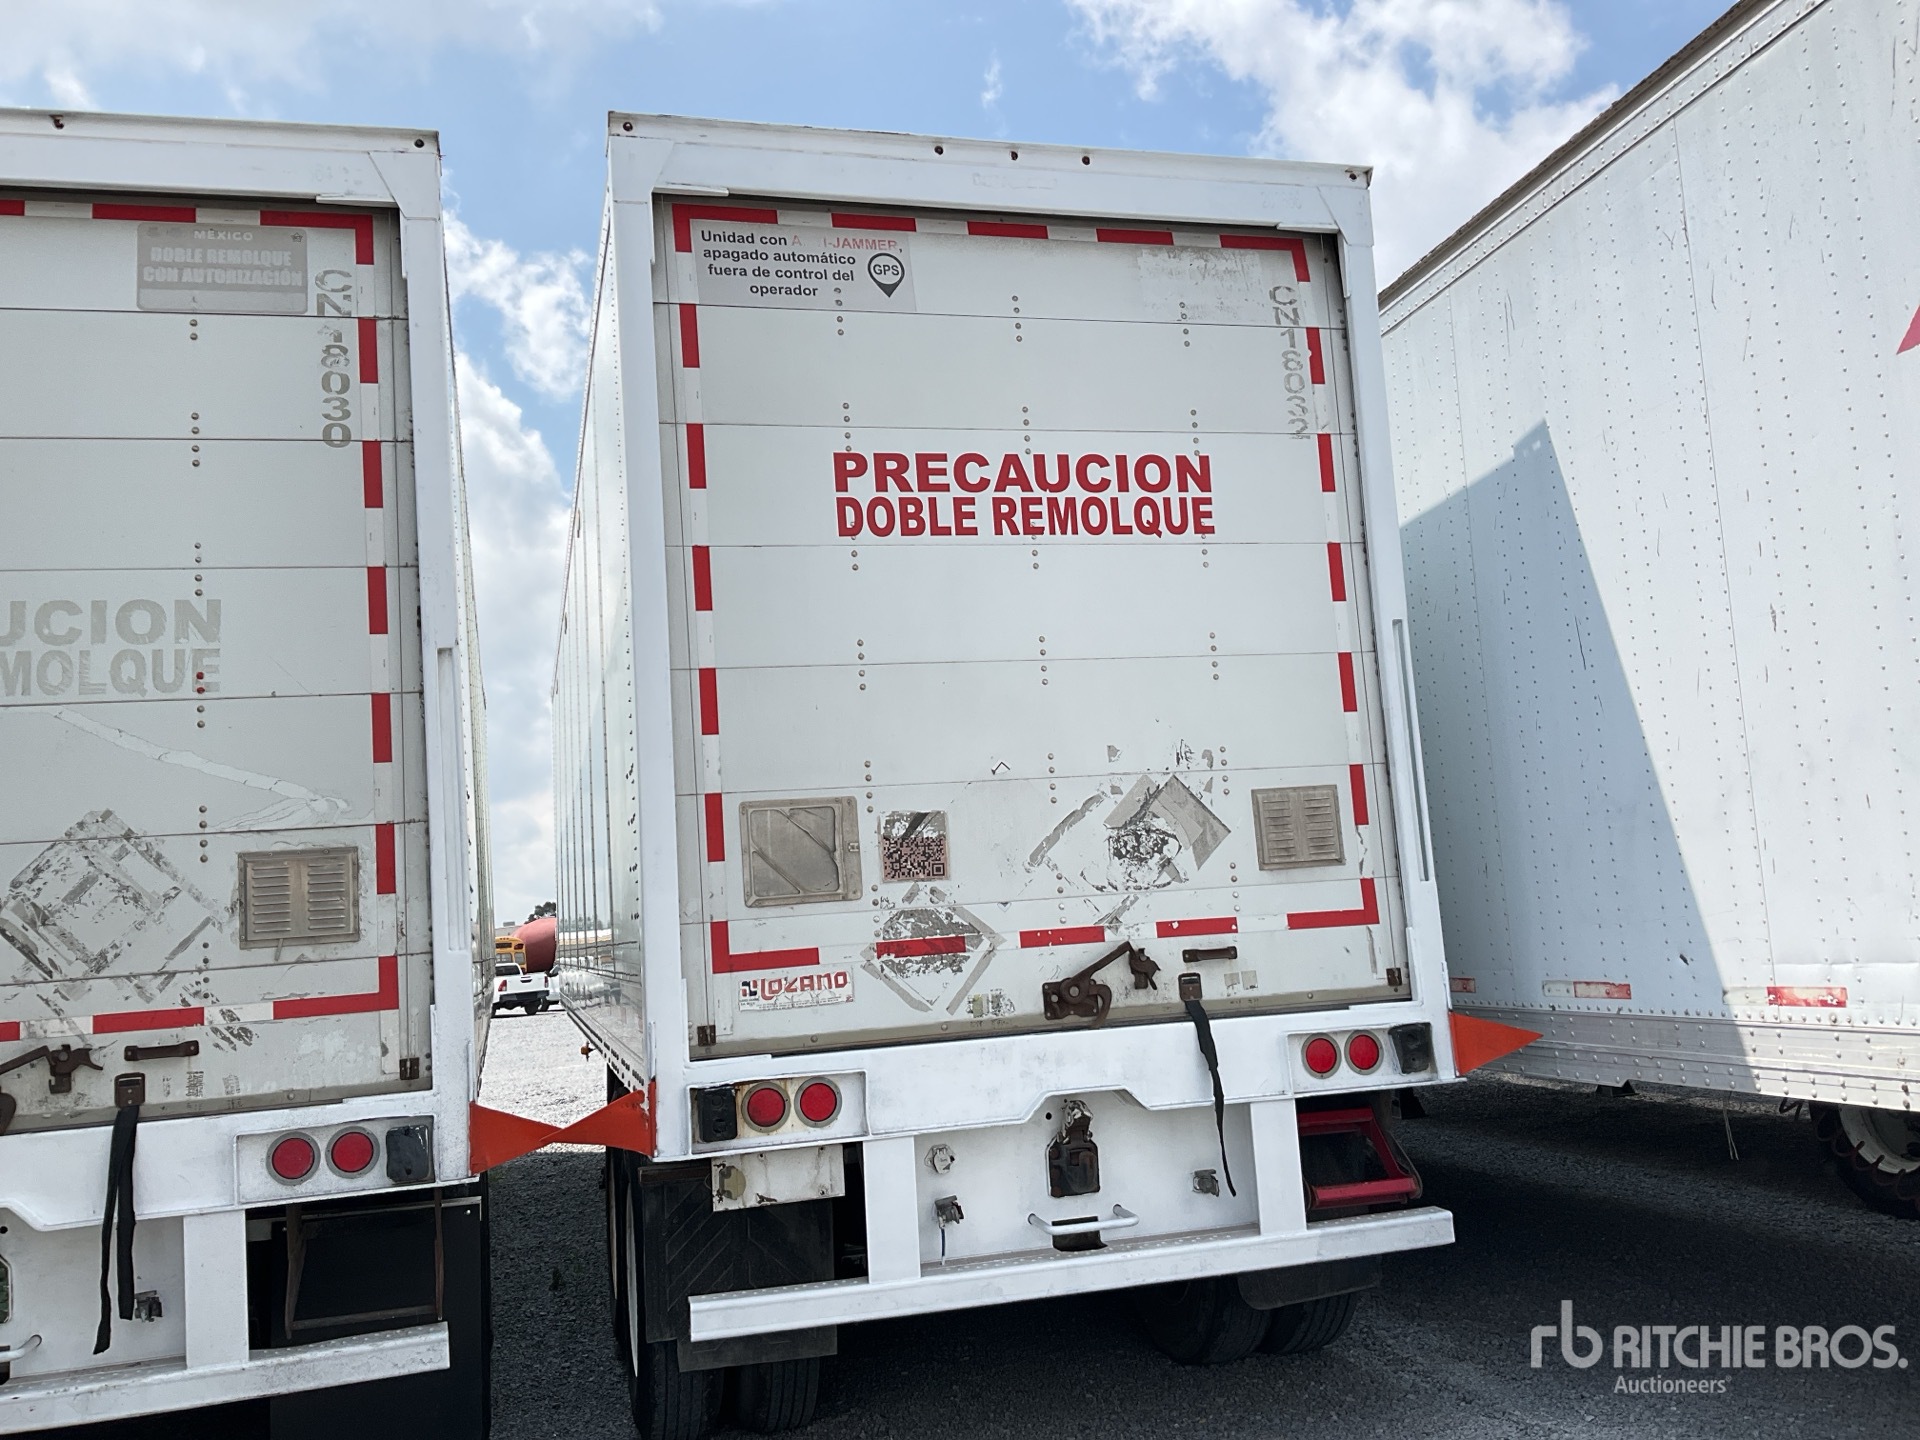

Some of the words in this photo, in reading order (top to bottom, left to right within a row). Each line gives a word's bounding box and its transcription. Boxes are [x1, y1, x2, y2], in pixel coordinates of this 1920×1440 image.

[700, 229, 756, 245] Unidad
[759, 235, 788, 247] con
[703, 248, 770, 262] apagado
[772, 251, 857, 266] automático
[707, 263, 749, 277] fuera
[752, 265, 771, 278] de
[774, 267, 829, 281] control
[832, 269, 856, 282] del
[872, 263, 901, 277] GPS
[749, 284, 819, 297] operador
[832, 451, 1213, 494] PRECAUCION
[836, 496, 979, 538] DOBLE
[991, 495, 1217, 540] REMOLQUE
